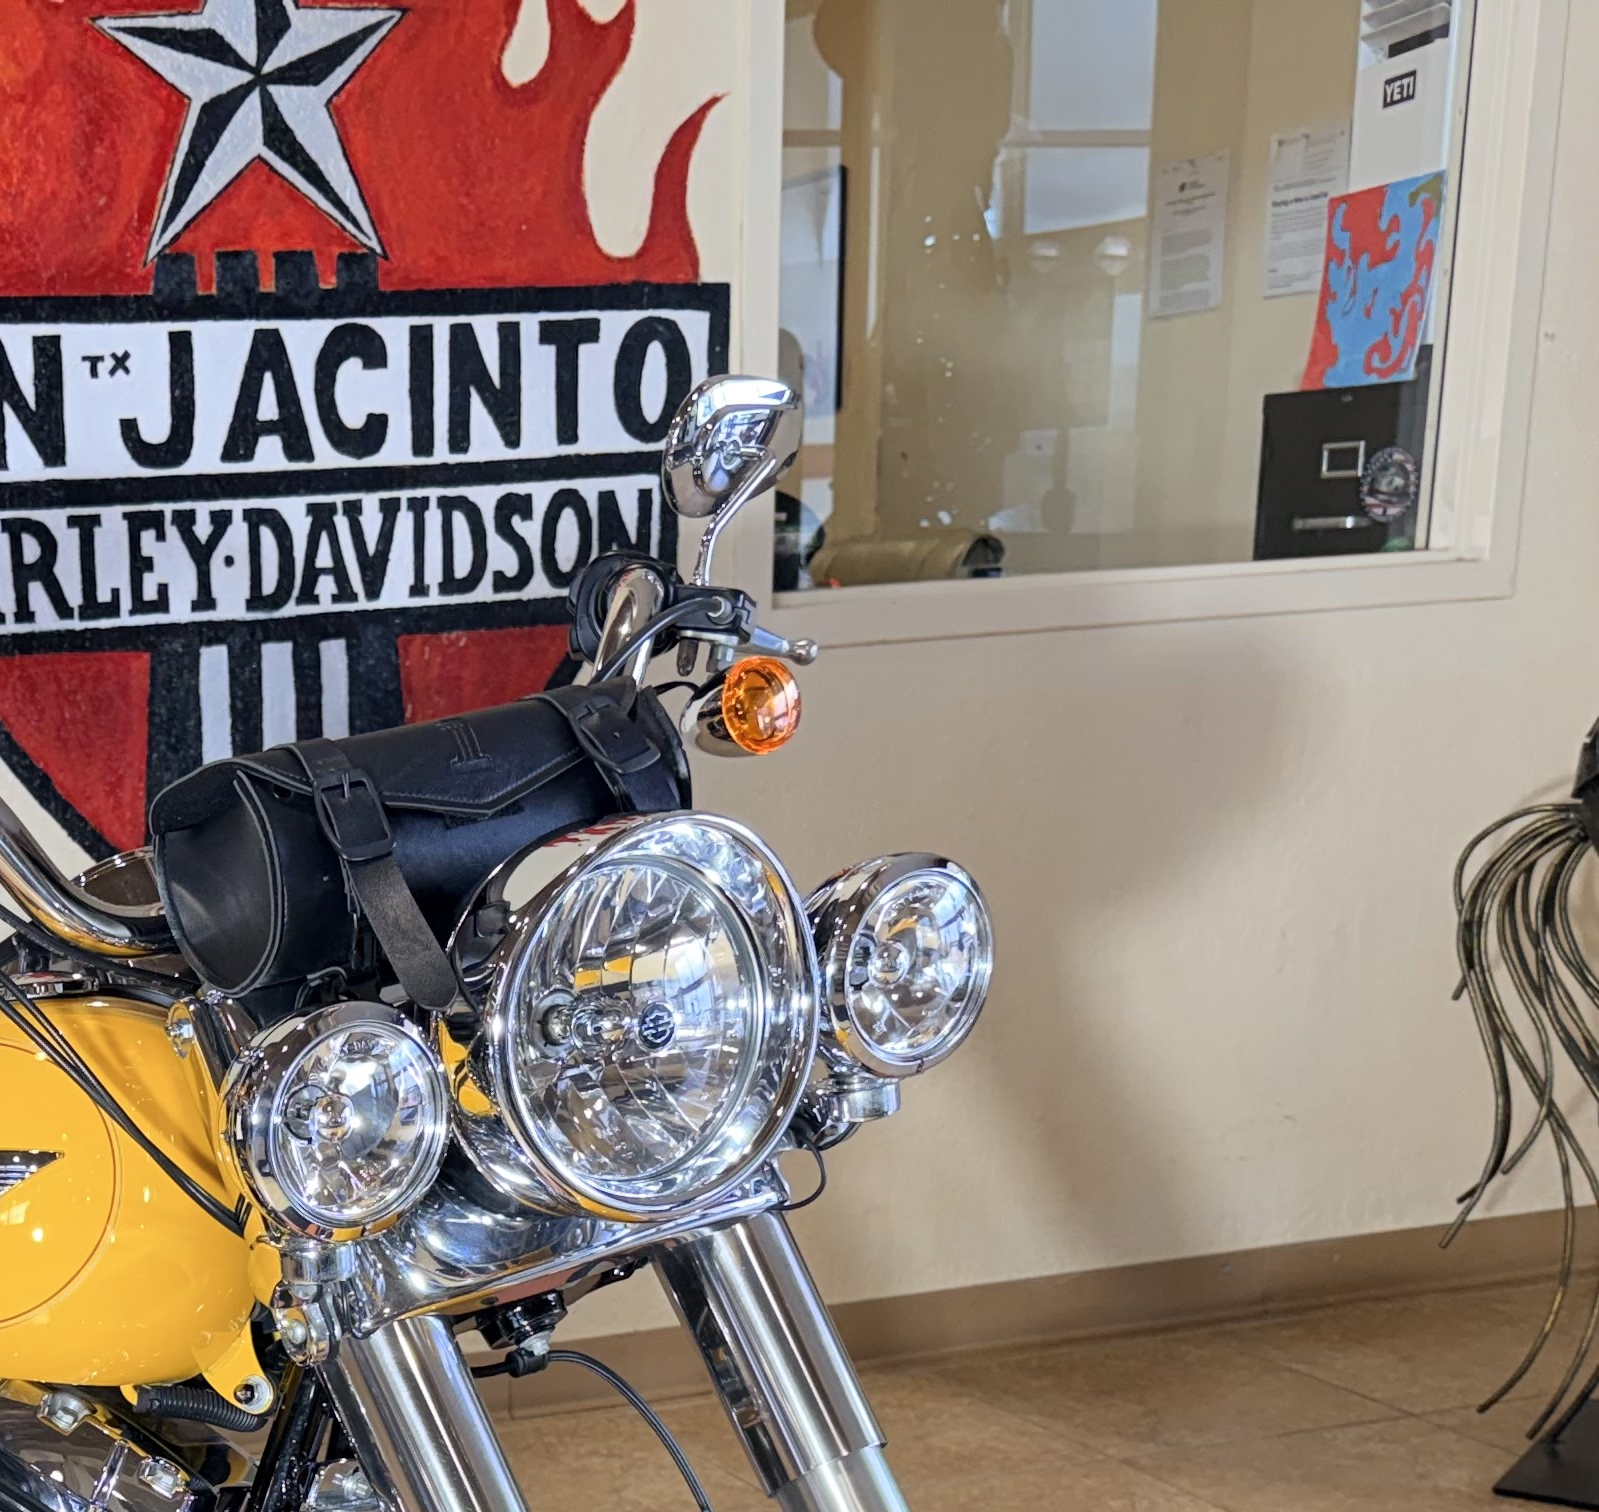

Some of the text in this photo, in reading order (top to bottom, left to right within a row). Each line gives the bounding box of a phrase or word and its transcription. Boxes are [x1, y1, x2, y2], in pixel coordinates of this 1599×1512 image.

[1385, 75, 1415, 103] YETI
[81, 349, 132, 380] TX
[119, 316, 692, 470] JACINTO
